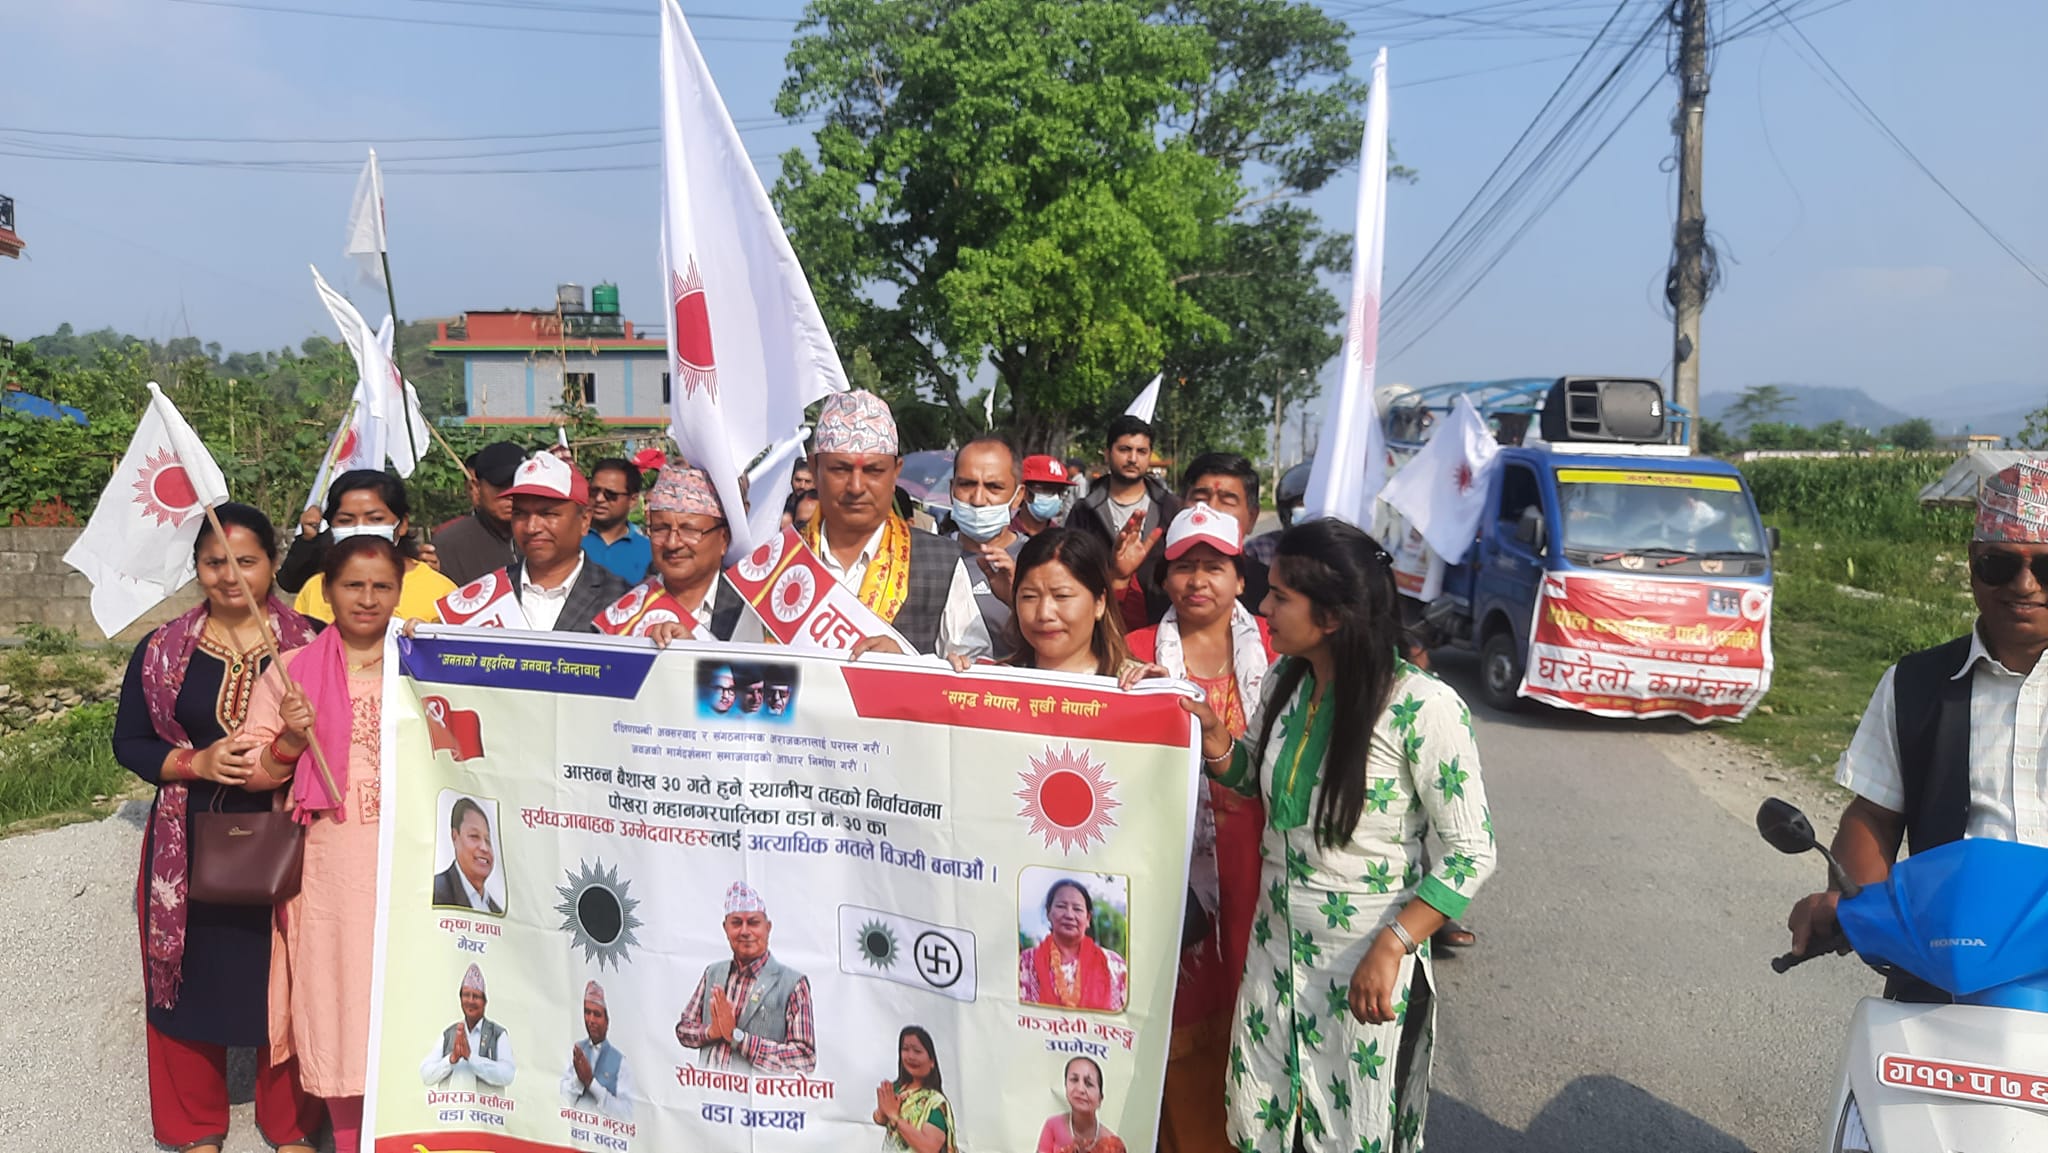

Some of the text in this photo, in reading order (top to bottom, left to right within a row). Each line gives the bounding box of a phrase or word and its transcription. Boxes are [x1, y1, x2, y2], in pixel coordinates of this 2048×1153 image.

[1539, 653, 1754, 699] घरदैलो कार्यक्रम
[608, 791, 648, 815] पोखरा
[653, 800, 780, 827] महानगरपालिका
[786, 810, 815, 827] वडा
[843, 815, 862, 832] ३०
[867, 820, 888, 836] का
[661, 776, 680, 792] ३०
[687, 775, 712, 795] गते
[716, 777, 743, 801] हुने
[749, 780, 813, 801] स्थानीय
[865, 788, 943, 821] निर्वाचनमा
[835, 838, 875, 861] मतले
[880, 841, 927, 873] विजयी
[475, 922, 501, 936] थापा
[1930, 938, 1987, 948] HONDA
[676, 1063, 835, 1100] सोमनाथ बास्तोला
[701, 1103, 734, 1125] वडा
